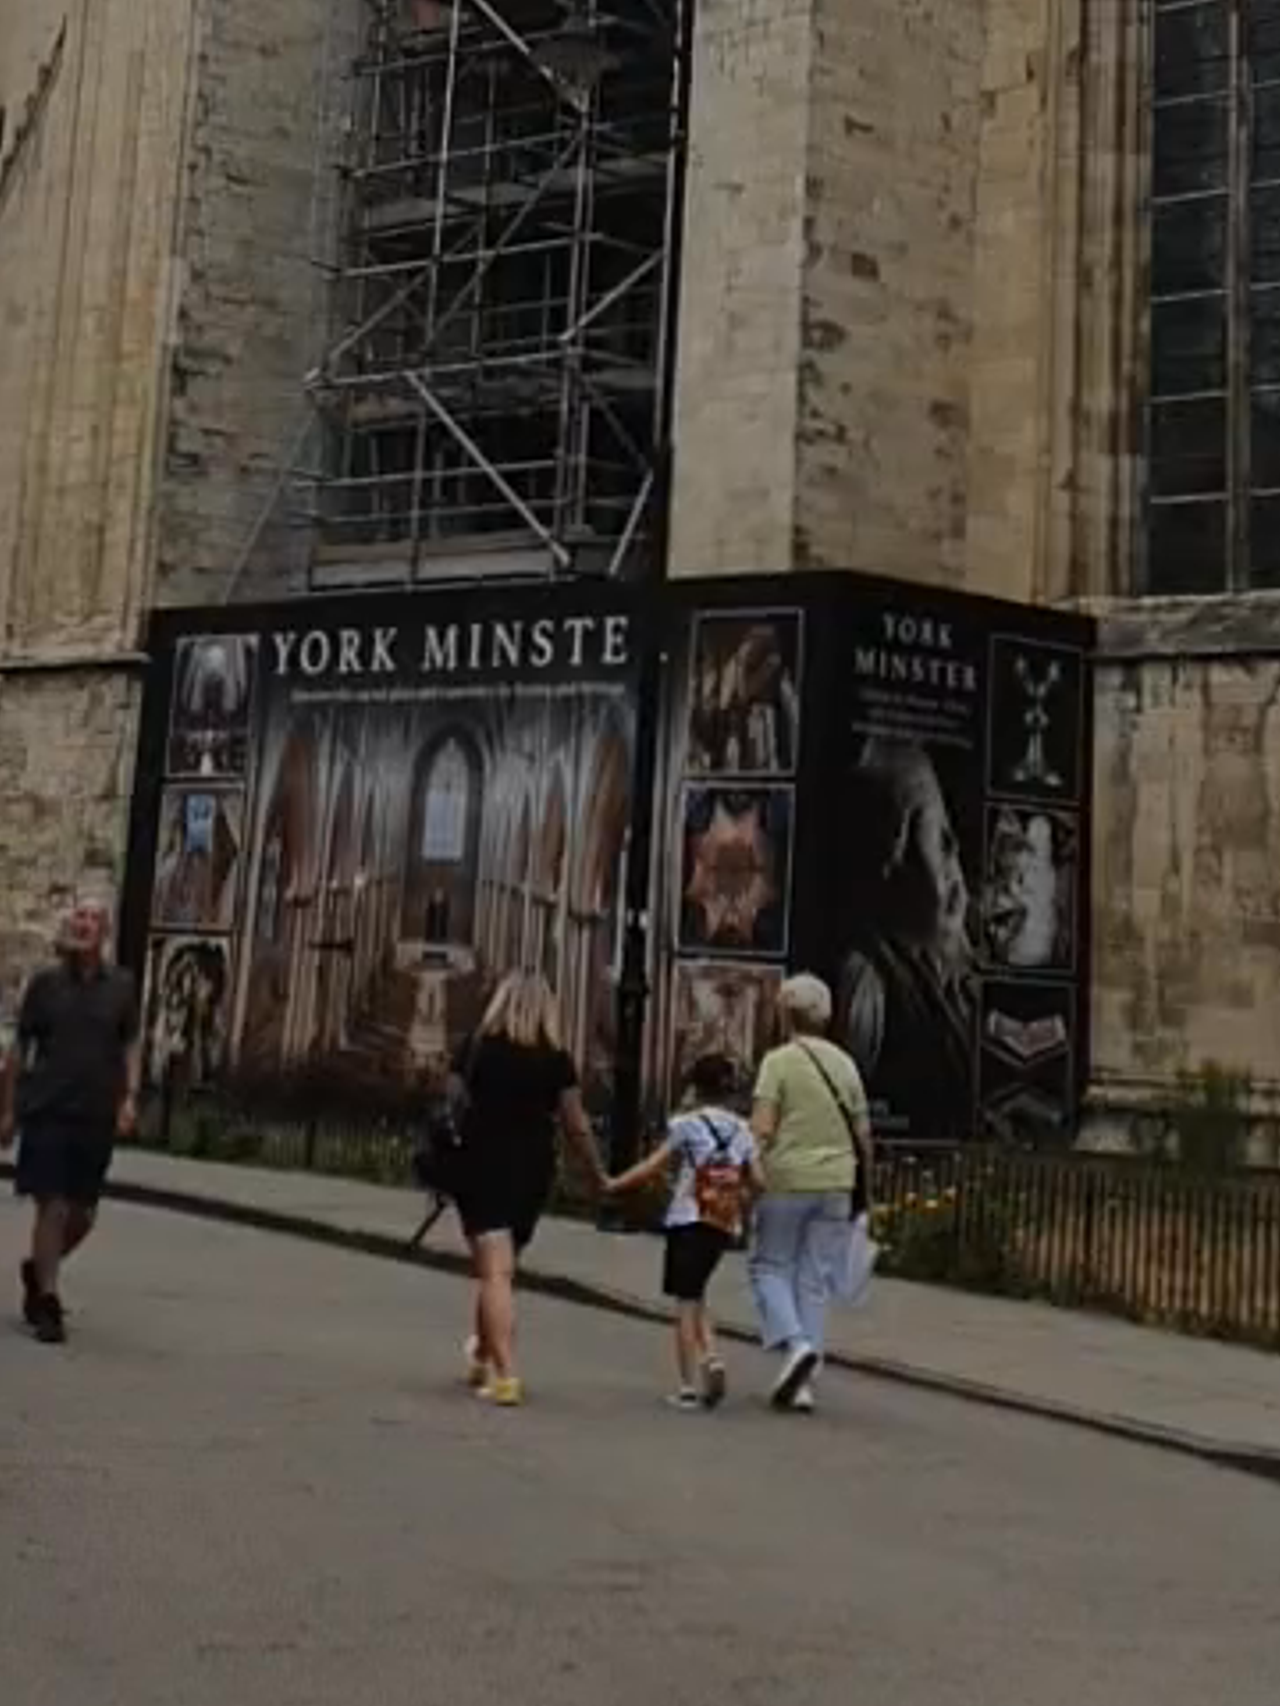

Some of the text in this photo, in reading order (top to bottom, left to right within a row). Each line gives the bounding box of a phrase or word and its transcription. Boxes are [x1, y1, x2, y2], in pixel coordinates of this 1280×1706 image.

[272, 616, 668, 676] YORK MINSTE
[883, 612, 952, 648] YORK
[854, 647, 977, 691] MINSTER
